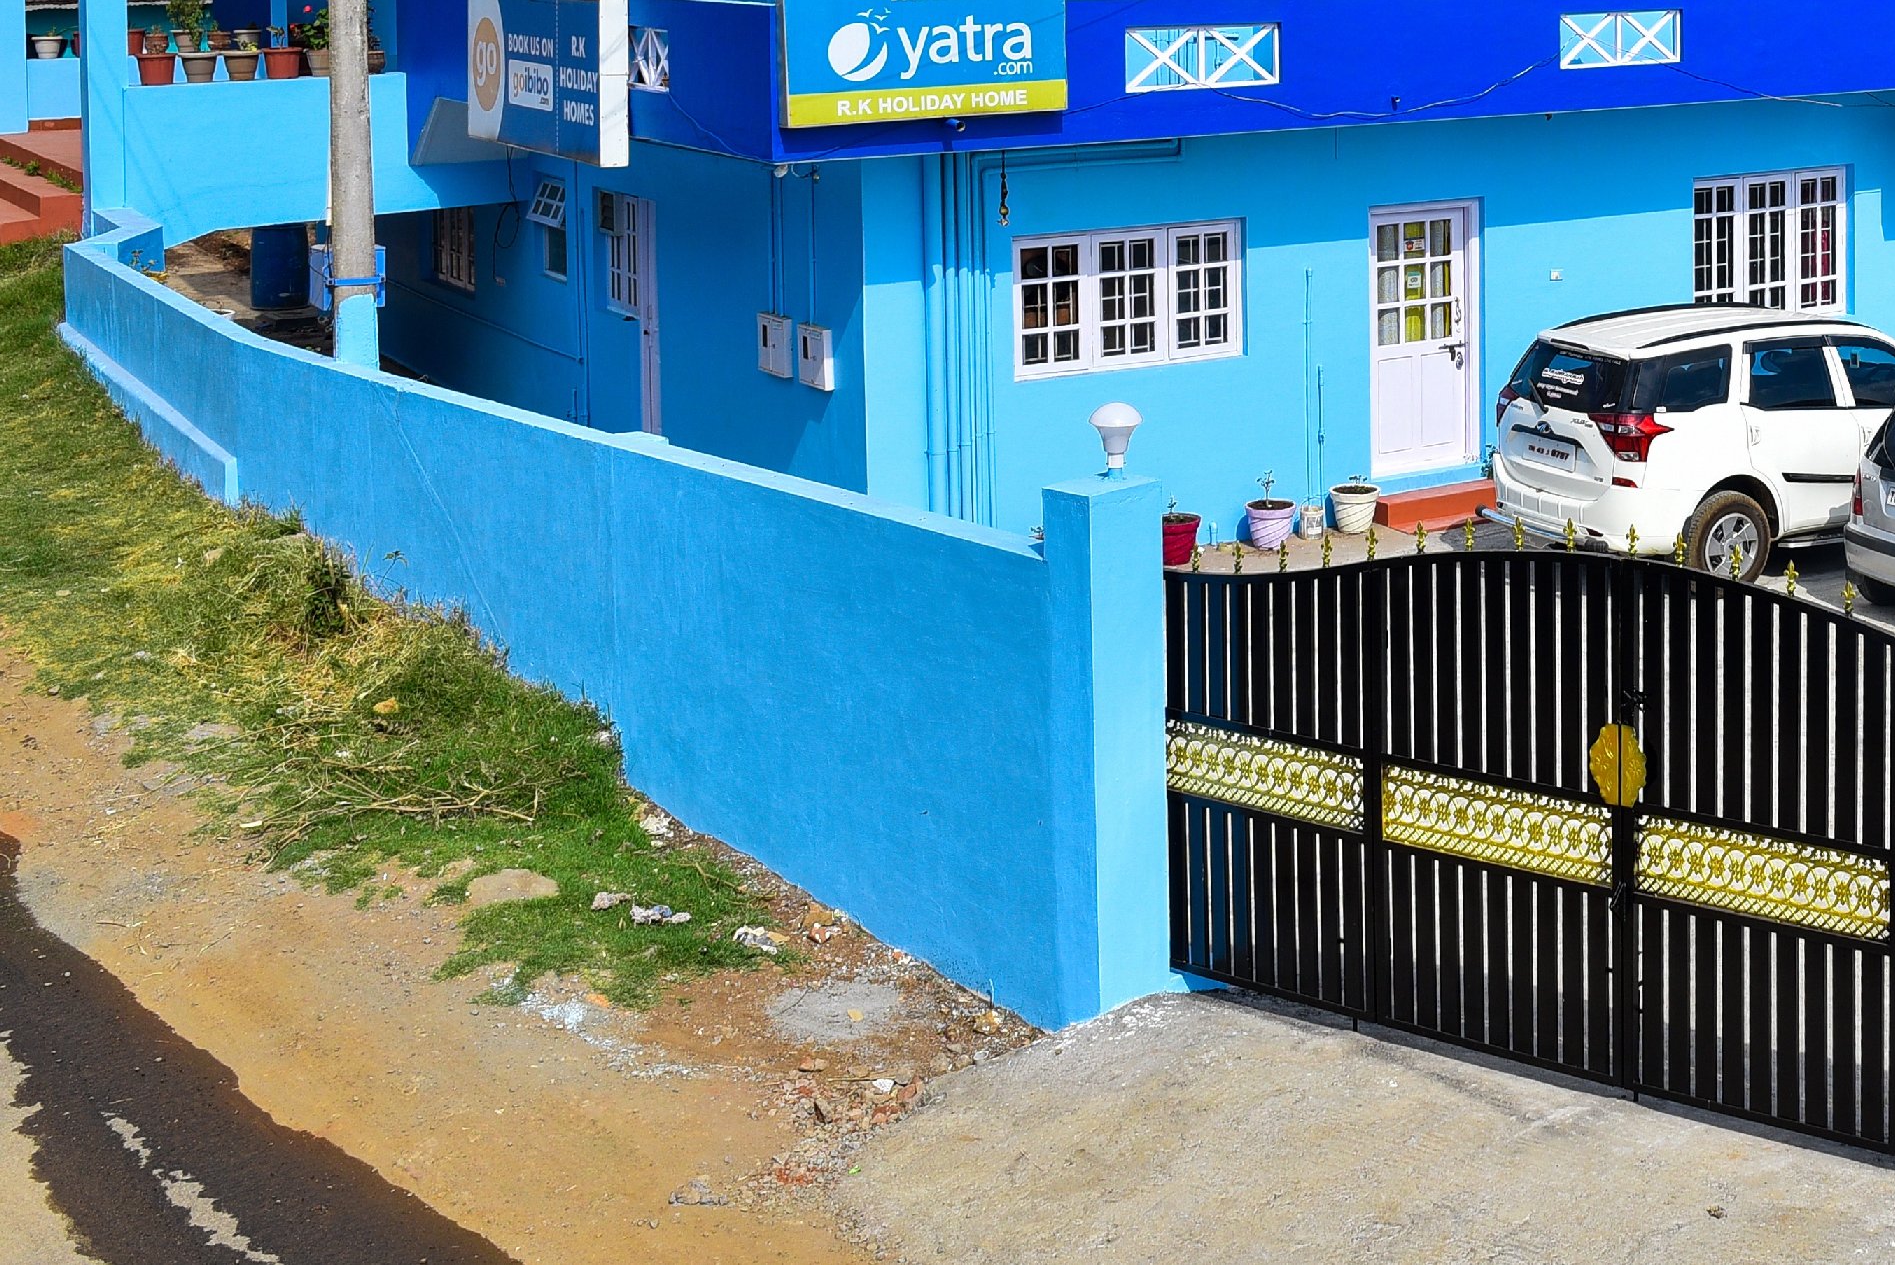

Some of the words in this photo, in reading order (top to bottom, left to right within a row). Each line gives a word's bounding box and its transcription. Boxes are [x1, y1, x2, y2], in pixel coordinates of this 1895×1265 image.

[508, 34, 529, 55] BOOK
[530, 37, 541, 56] US
[541, 37, 554, 58] ON
[571, 35, 586, 59] R.K
[897, 15, 1033, 80] yatra
[476, 39, 498, 86] go
[993, 60, 1033, 76] .com
[513, 67, 549, 97] goibibo
[559, 67, 598, 94] HOLIDAY
[563, 100, 595, 126] HOMES
[837, 98, 872, 117] R.K
[878, 92, 966, 114] HOLIDAY
[972, 89, 1028, 108] HOME
